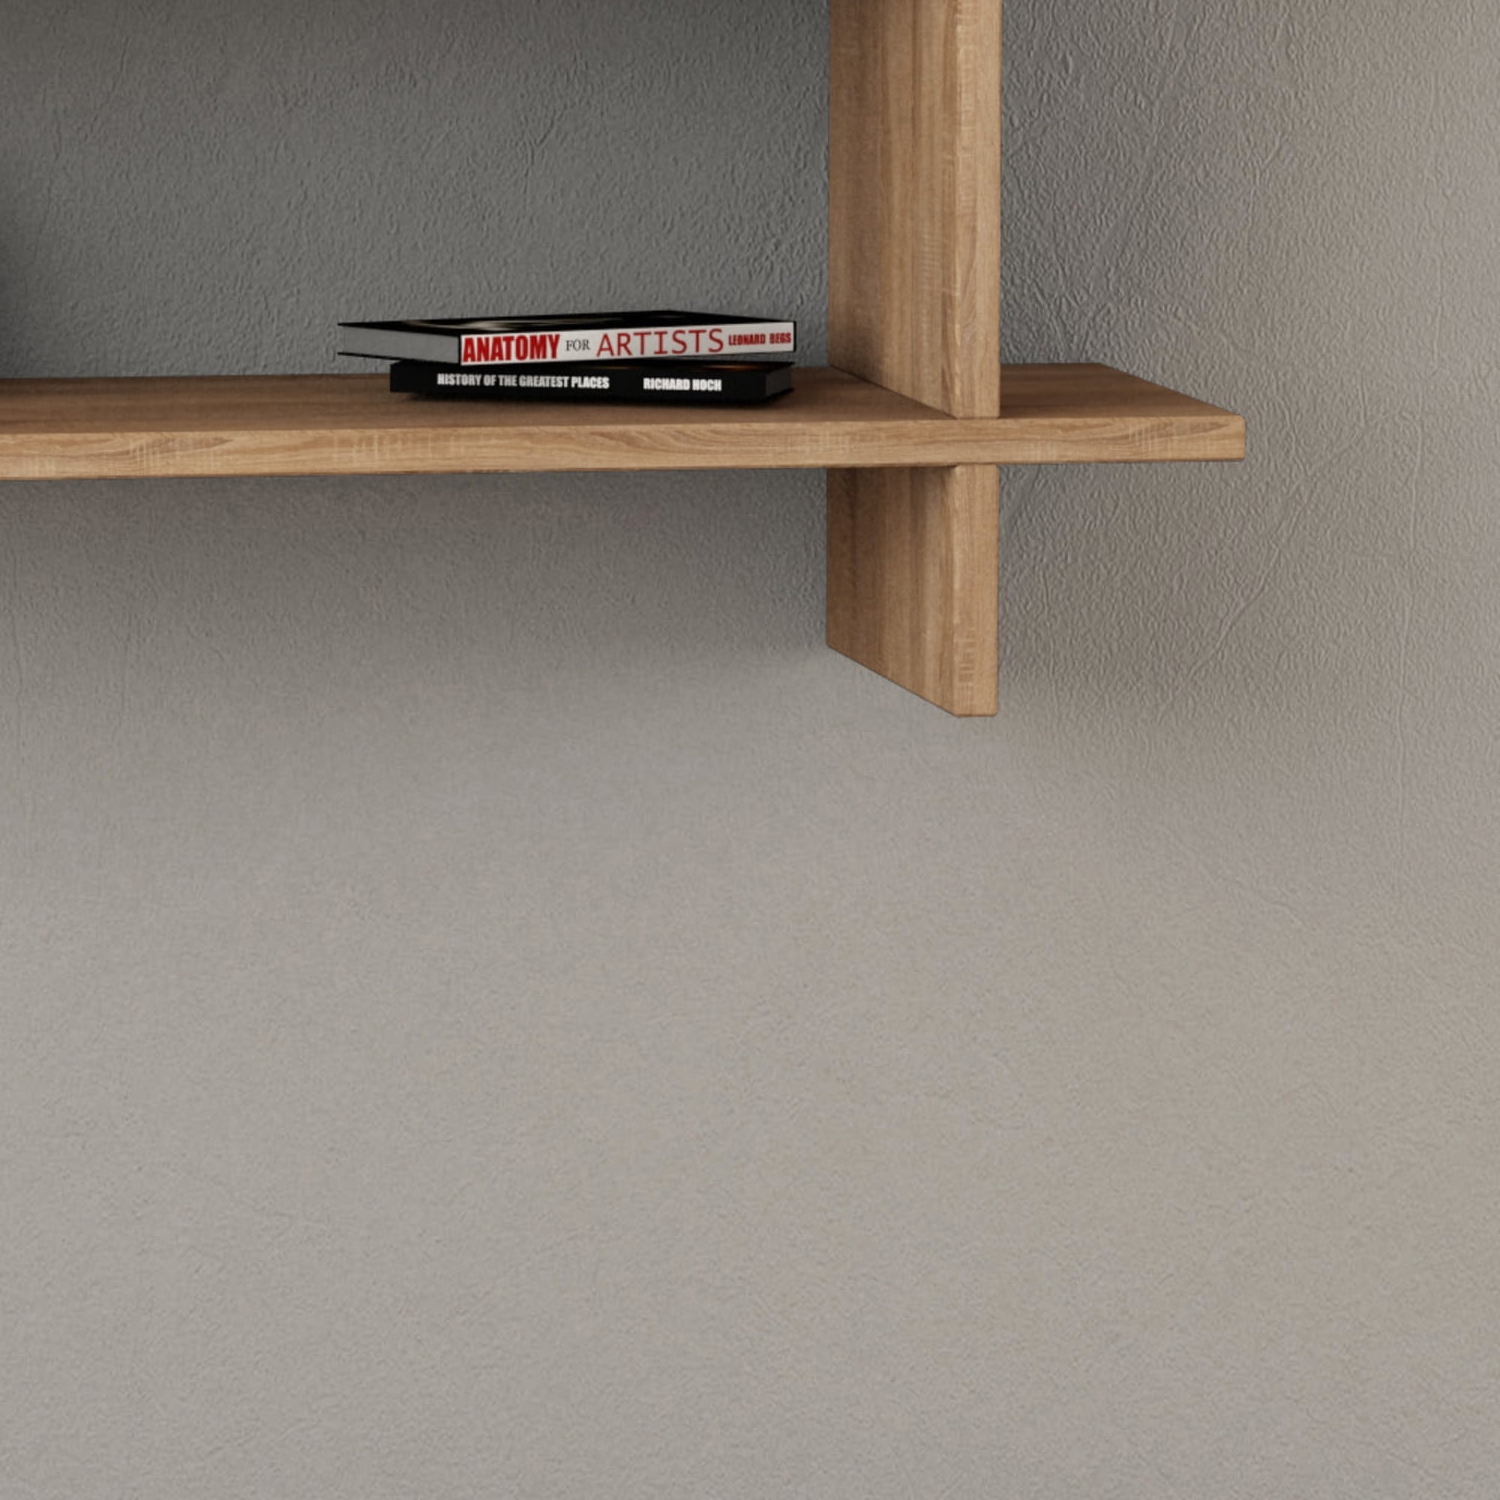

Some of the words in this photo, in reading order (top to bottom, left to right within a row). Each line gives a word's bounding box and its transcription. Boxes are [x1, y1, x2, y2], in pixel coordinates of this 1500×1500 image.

[462, 333, 560, 363] ANATOMY
[565, 339, 590, 352] FOR
[596, 328, 725, 357] ARTISTS
[728, 333, 766, 346] LEONARD
[437, 373, 481, 386] HISTORY
[483, 374, 497, 387] OF
[498, 375, 517, 387] THE
[518, 375, 569, 388] GREATEST
[570, 376, 610, 389] PLACES
[643, 377, 690, 391] RICHARD
